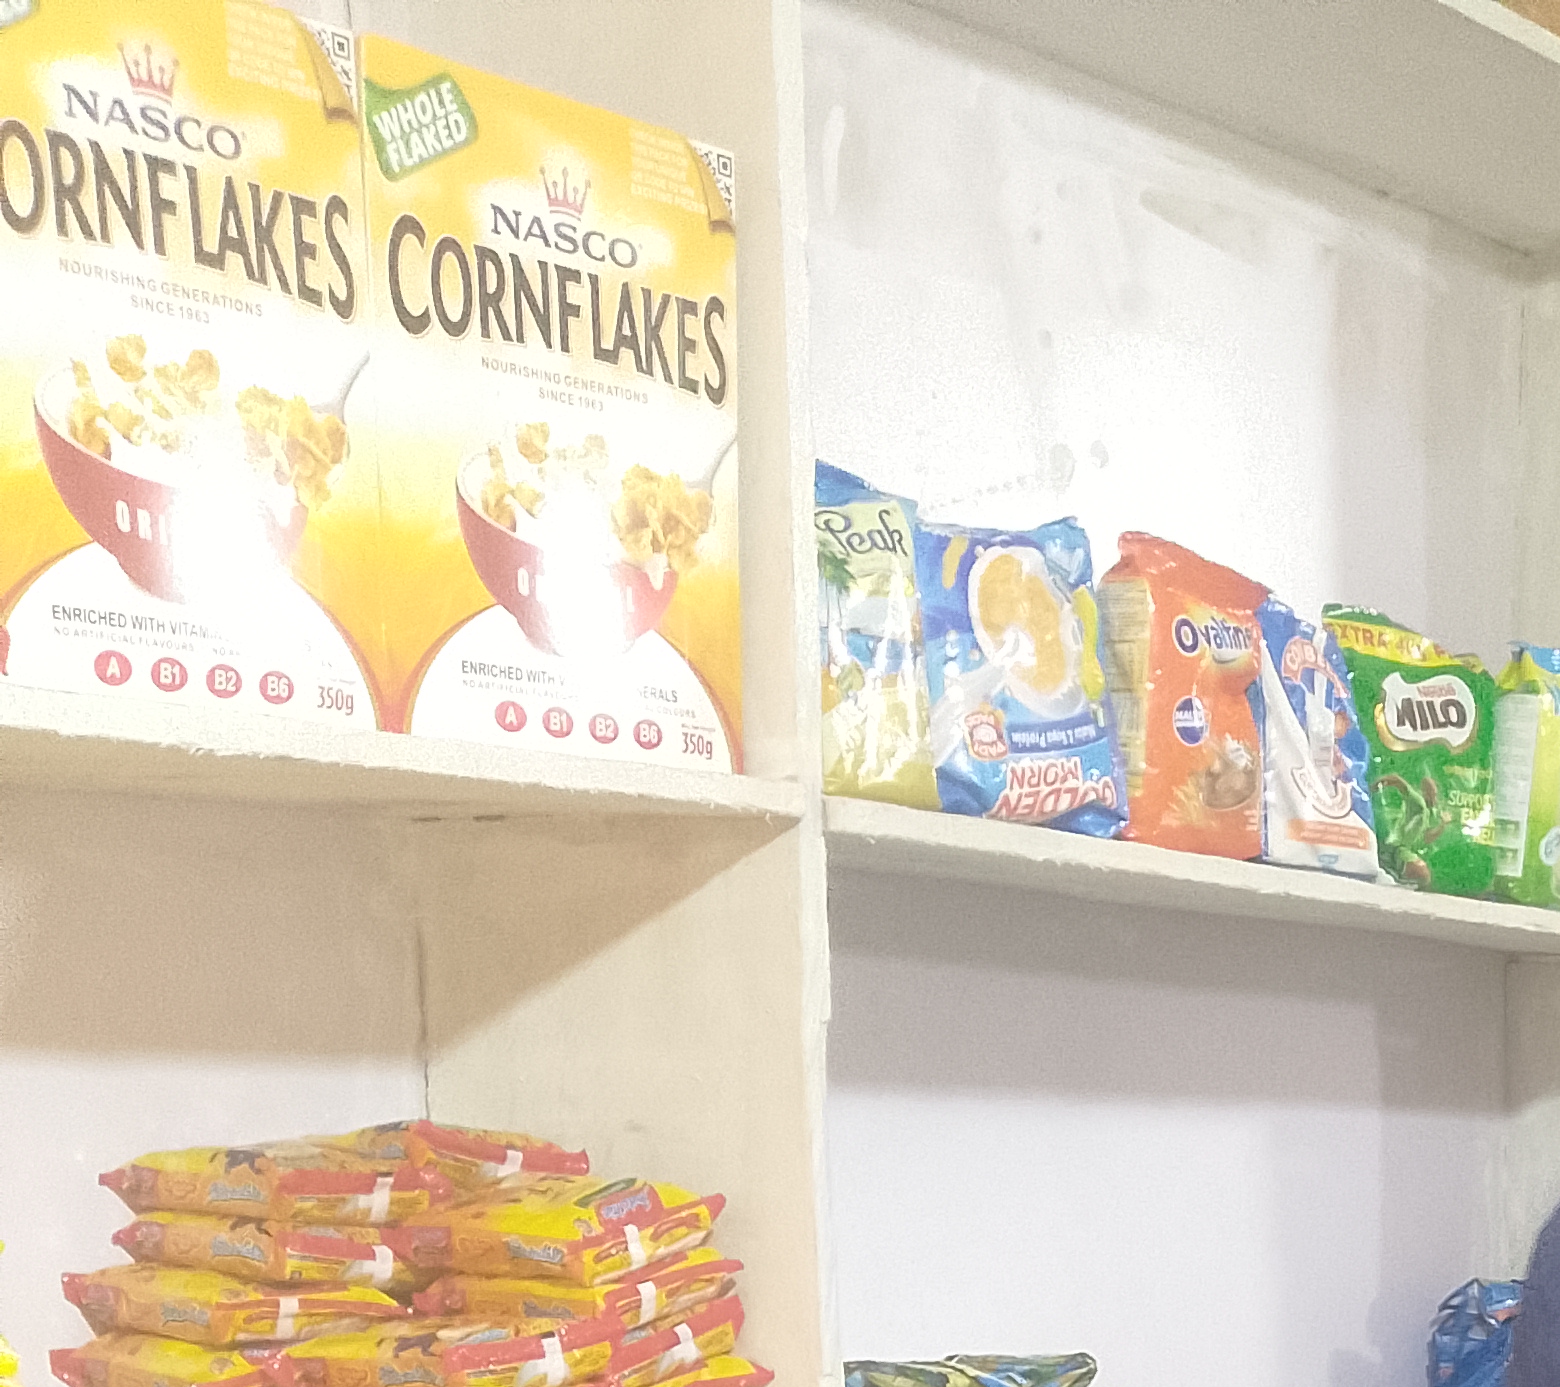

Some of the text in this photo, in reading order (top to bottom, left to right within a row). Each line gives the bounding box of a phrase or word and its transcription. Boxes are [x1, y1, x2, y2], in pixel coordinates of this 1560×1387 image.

[62, 83, 242, 160] NASCO
[373, 82, 459, 144] WHOLE
[386, 111, 468, 174] FLAKED
[490, 203, 638, 269] NASCO
[58, 257, 264, 318] NOURISHING GENERATIONS
[130, 295, 210, 324] SINCE 1963
[388, 214, 726, 406] CORNFLAKES
[481, 356, 649, 405] NOURISHING GENERATIONS
[539, 386, 574, 406] SINCE
[815, 509, 910, 557] Peak
[52, 604, 127, 628] ENRICHED
[131, 614, 166, 634] WITH
[159, 661, 181, 686] B1
[213, 668, 238, 692] B2
[267, 676, 290, 699] B6
[461, 660, 523, 682] ENRICHED
[316, 685, 355, 717] 350g
[1395, 696, 1468, 733] MILO
[549, 711, 567, 732] B1
[595, 718, 616, 738] B2
[639, 724, 659, 744] B6
[681, 731, 713, 760] 350g
[1008, 761, 1081, 790] MORN
